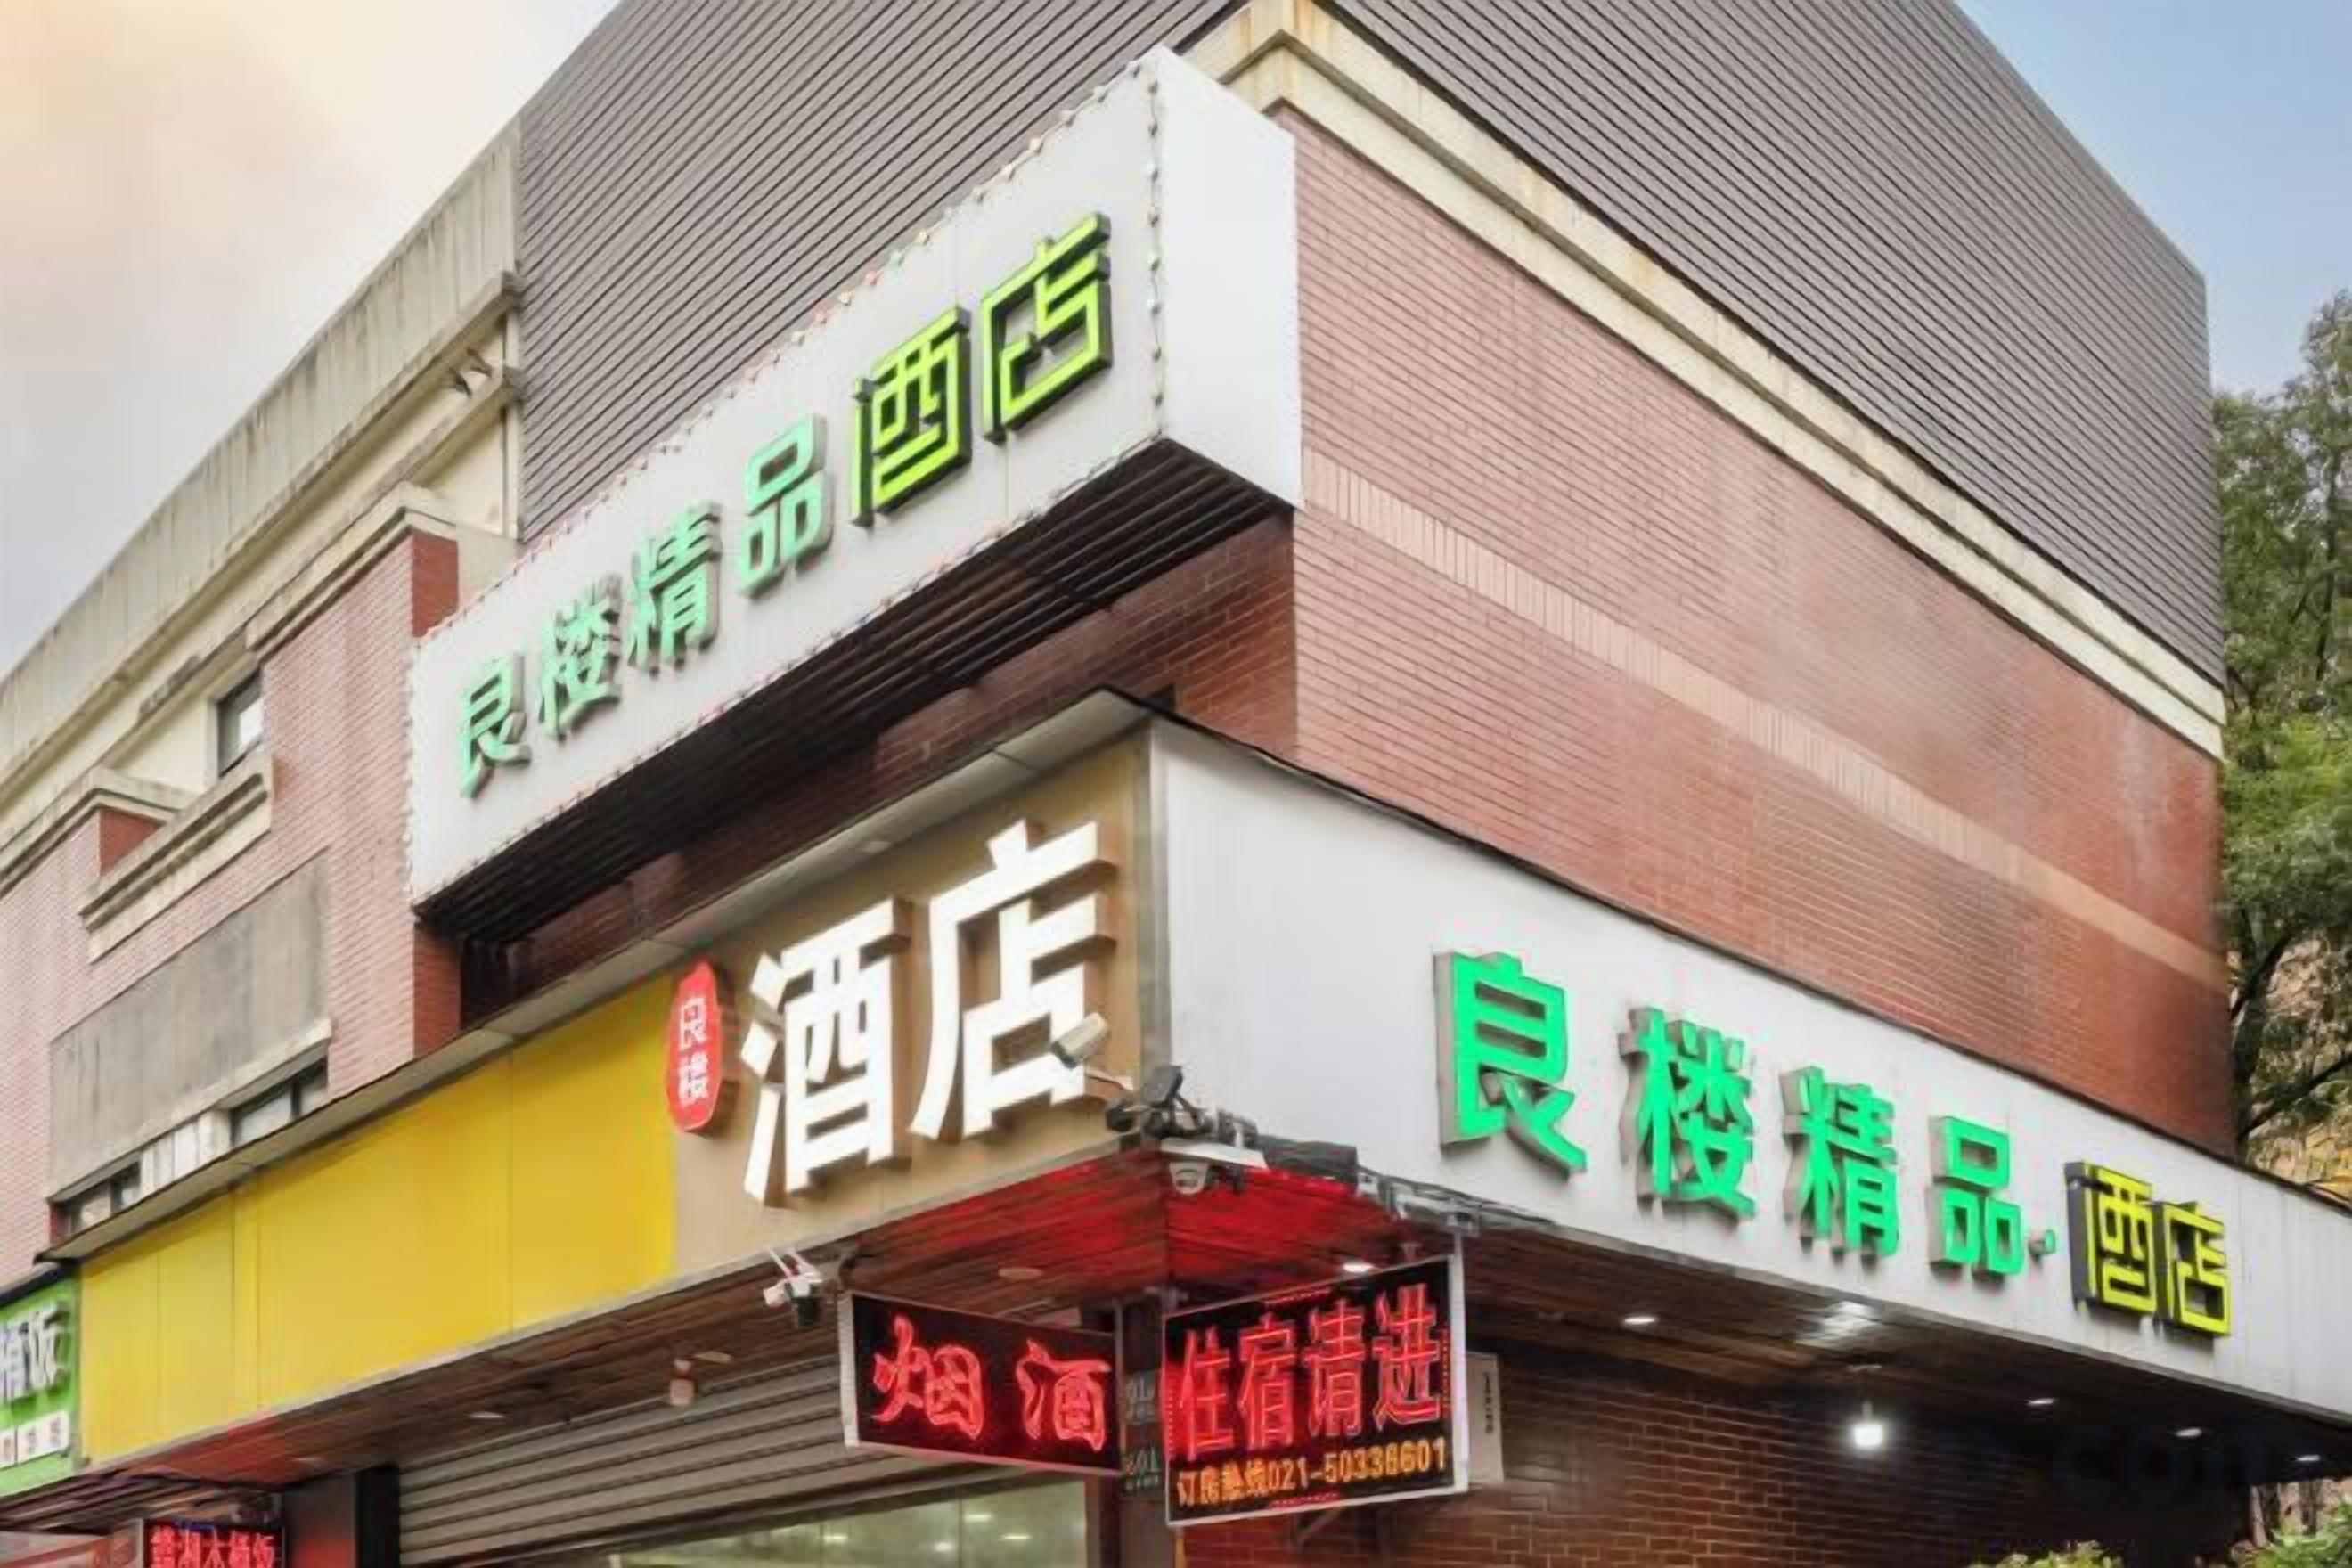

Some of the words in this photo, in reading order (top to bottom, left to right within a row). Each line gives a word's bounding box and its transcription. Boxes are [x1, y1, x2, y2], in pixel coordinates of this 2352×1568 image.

[458, 211, 1111, 798] 良楼精品酒店
[740, 818, 1103, 1204] 酒店
[870, 1313, 1111, 1452] 烟酒
[1178, 1283, 1441, 1461] 住宿请进
